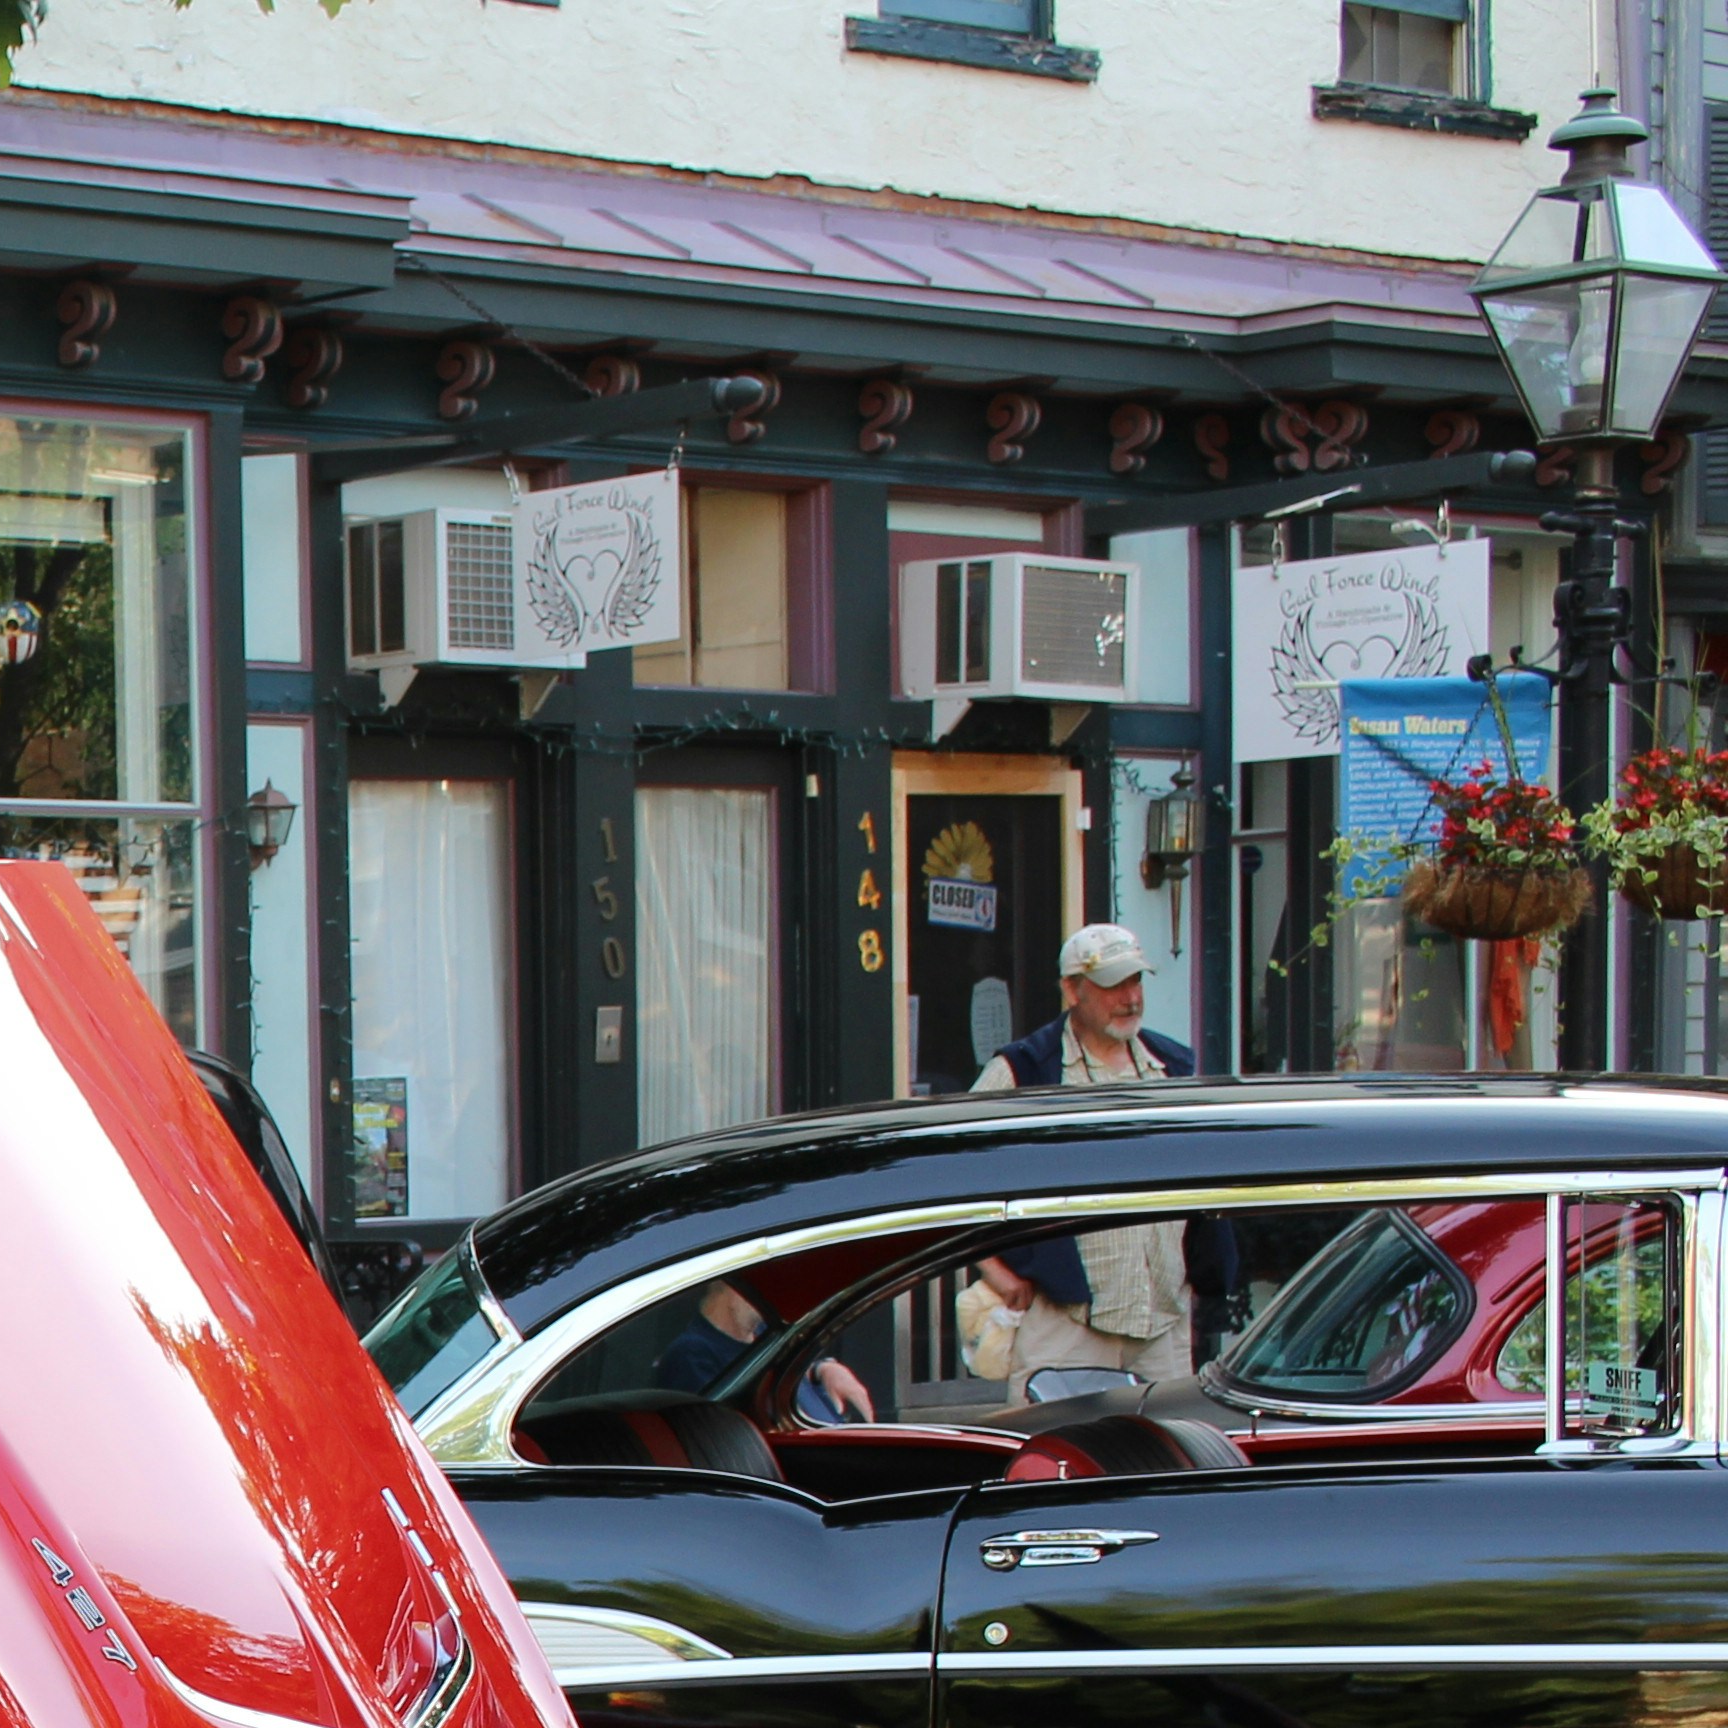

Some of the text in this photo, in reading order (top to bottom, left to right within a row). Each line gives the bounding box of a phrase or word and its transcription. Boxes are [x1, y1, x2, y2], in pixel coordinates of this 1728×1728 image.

[565, 489, 605, 515] Force
[607, 482, 654, 520] Winds
[1279, 559, 1440, 619] Gail Force Winds
[1348, 714, 1468, 736] Susan Waters
[593, 818, 625, 979] 150
[858, 811, 884, 973] 148
[932, 884, 975, 909] CLOSED
[1605, 1367, 1642, 1391] SNIFF
[30, 1536, 139, 1673] 427
